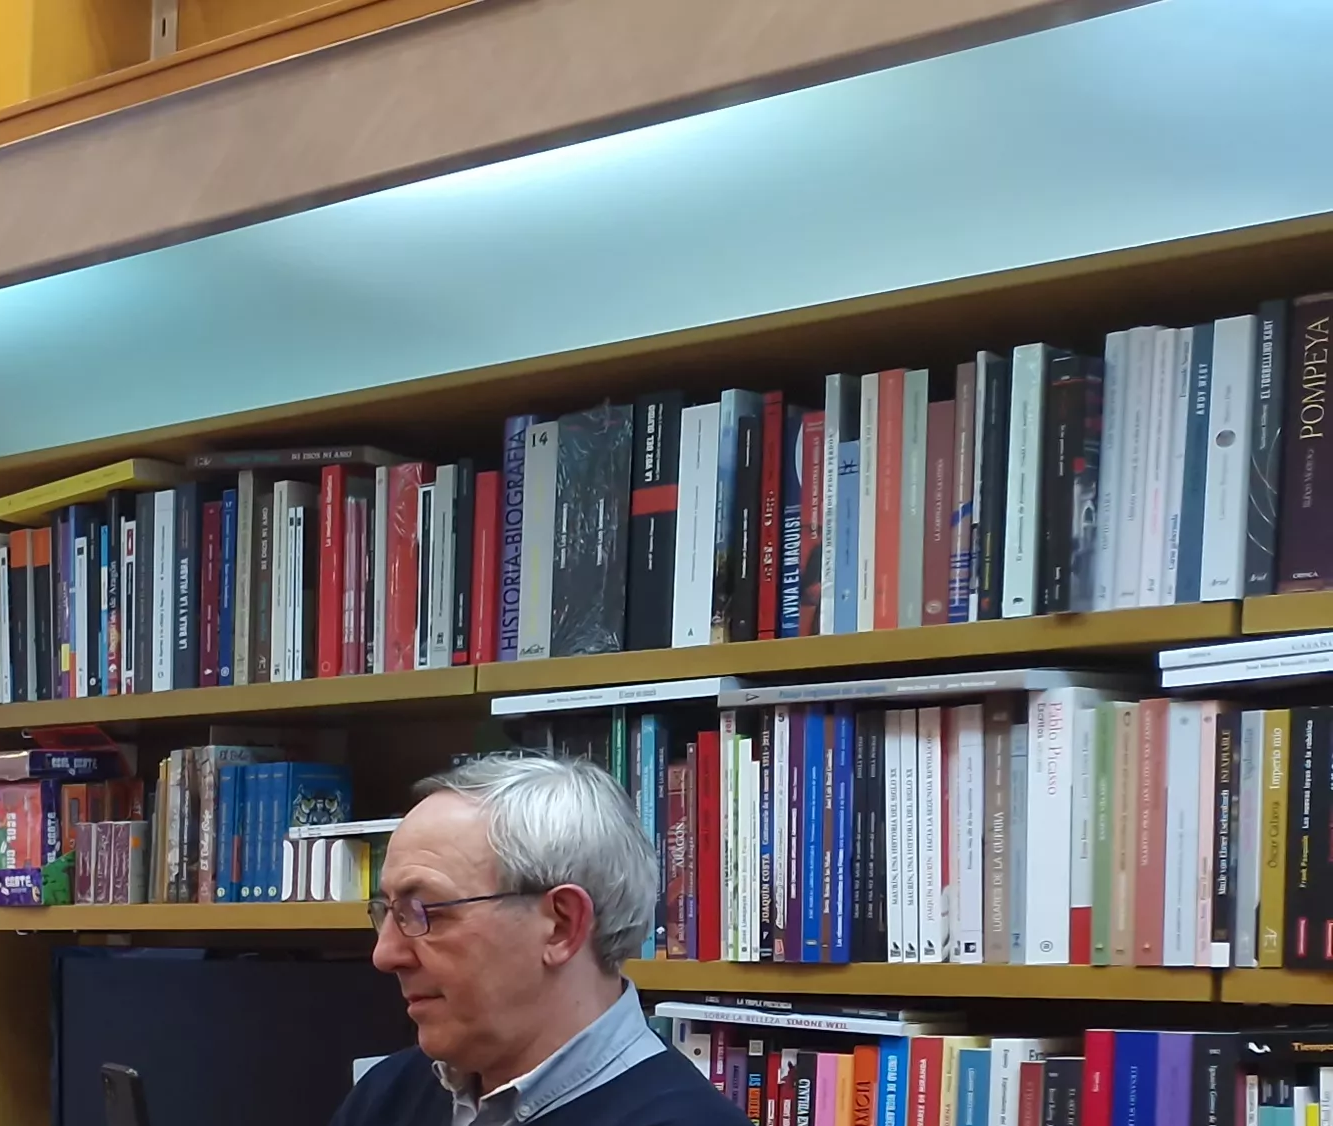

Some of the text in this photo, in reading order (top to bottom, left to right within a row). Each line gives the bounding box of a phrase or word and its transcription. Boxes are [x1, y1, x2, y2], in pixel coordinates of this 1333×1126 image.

[1299, 316, 1330, 439] POMPEYA
[179, 557, 189, 594] PALABRA
[782, 517, 801, 618] ¡VIVA EL MAQUIS!
[180, 595, 188, 607] LA
[179, 615, 188, 637] BALA
[179, 638, 188, 649] LA
[1047, 701, 1063, 796] Pablo Picasso
[890, 768, 897, 778] XX
[906, 768, 913, 778] XX
[906, 820, 914, 855] HISTORIA
[994, 857, 1002, 869] LA
[993, 872, 1002, 885] DE
[993, 887, 1003, 932] LUGARES
[703, 1012, 729, 1020] SOBRE
[745, 1014, 781, 1024] BELLEZA
[786, 1018, 823, 1028] SIMONE
[826, 1021, 848, 1029] WEIL
[918, 1058, 927, 1092] MIRANDA
[797, 1078, 810, 1114] CYNTHIA
[917, 1094, 925, 1103] DE
